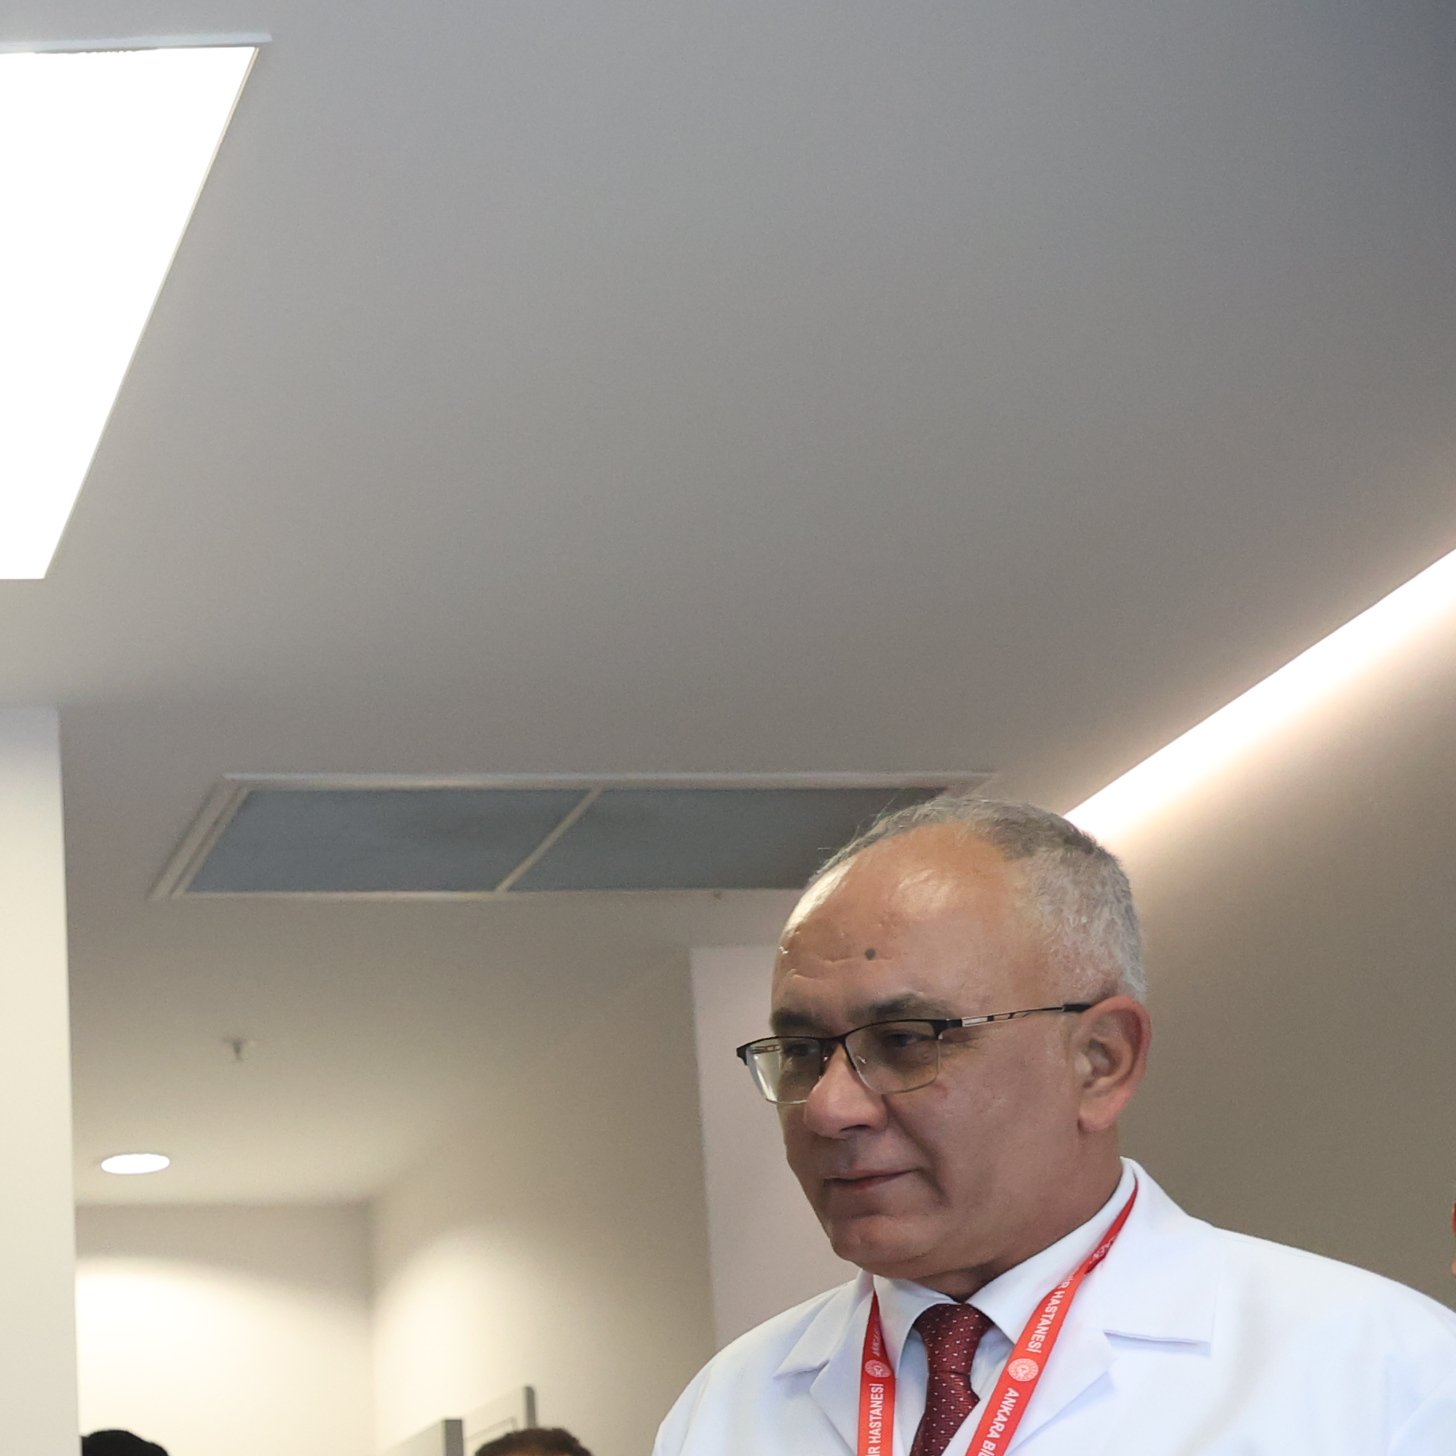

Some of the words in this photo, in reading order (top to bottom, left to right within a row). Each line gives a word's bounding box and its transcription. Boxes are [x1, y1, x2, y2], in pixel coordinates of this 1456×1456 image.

[1026, 1290, 1066, 1354] HASTANESİ
[869, 1382, 885, 1445] HASTANESİ
[987, 1386, 1020, 1440] ANKARA
